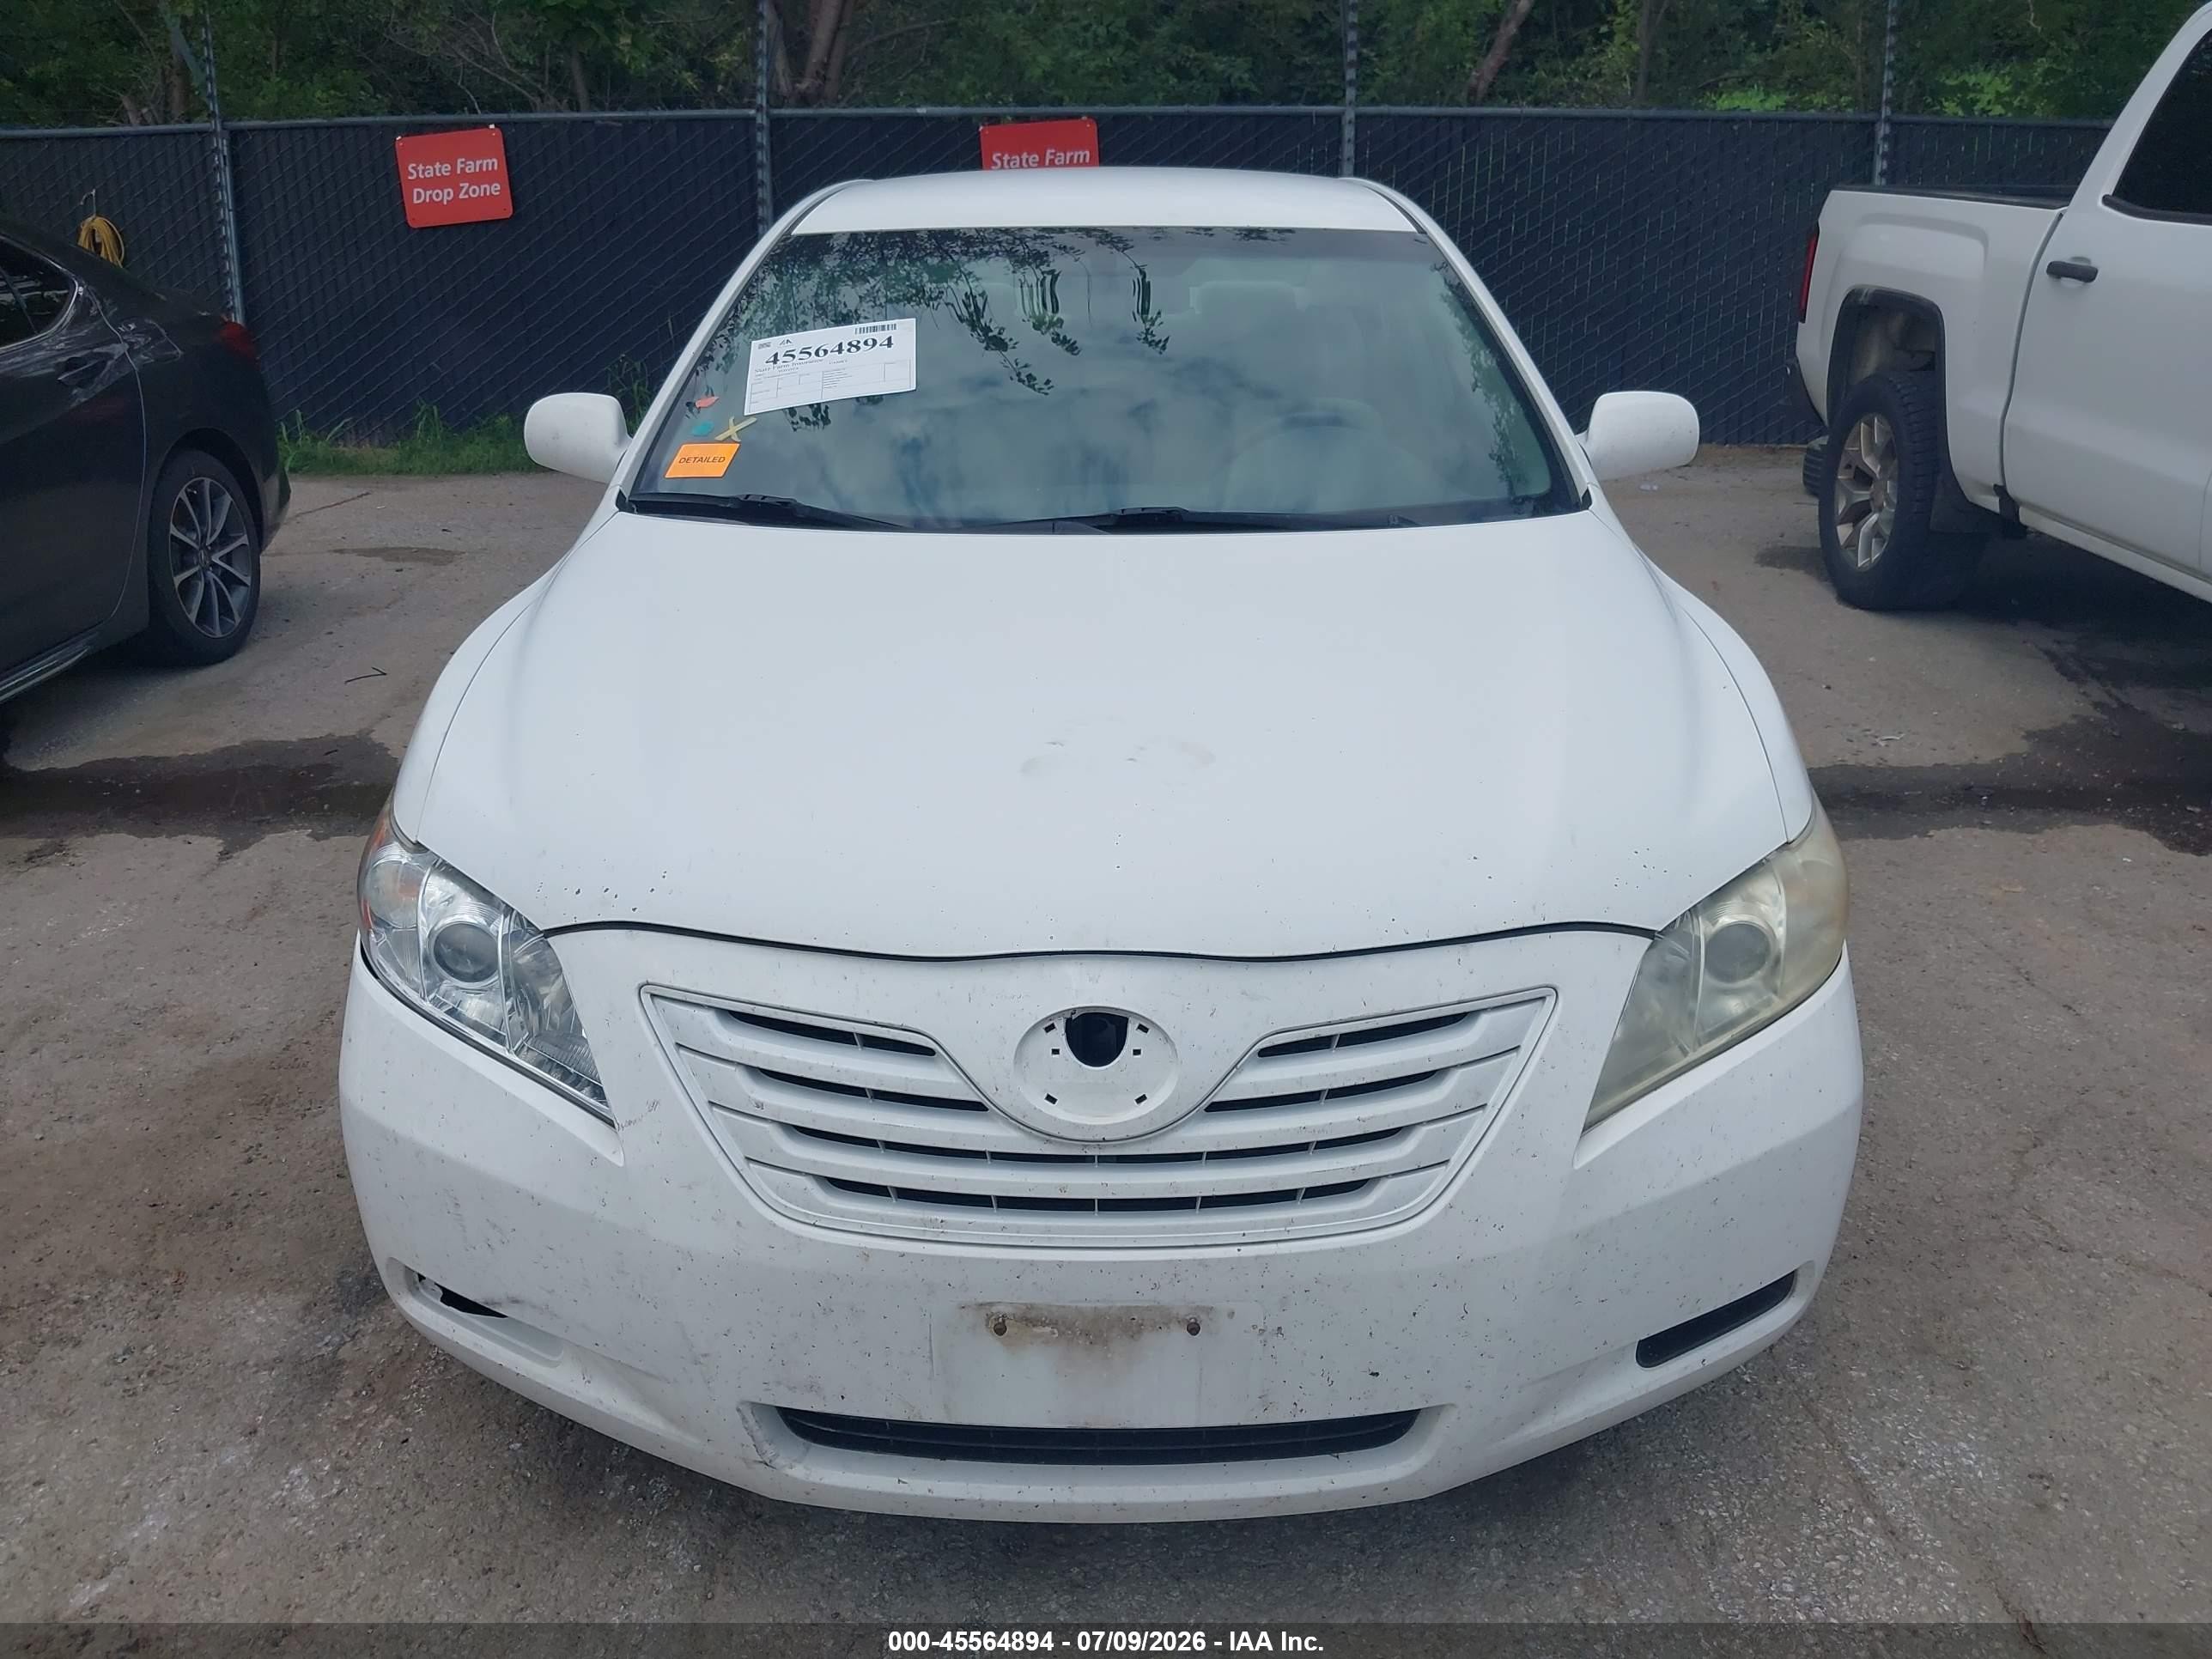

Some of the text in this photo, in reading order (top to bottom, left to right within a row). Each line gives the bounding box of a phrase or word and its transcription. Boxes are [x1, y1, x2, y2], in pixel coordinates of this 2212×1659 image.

[407, 158, 498, 179] State Farm
[991, 149, 1090, 170] State Farm
[413, 182, 501, 205] Drop Zone
[765, 335, 894, 365] 45564894
[678, 454, 726, 465] DETAILED
